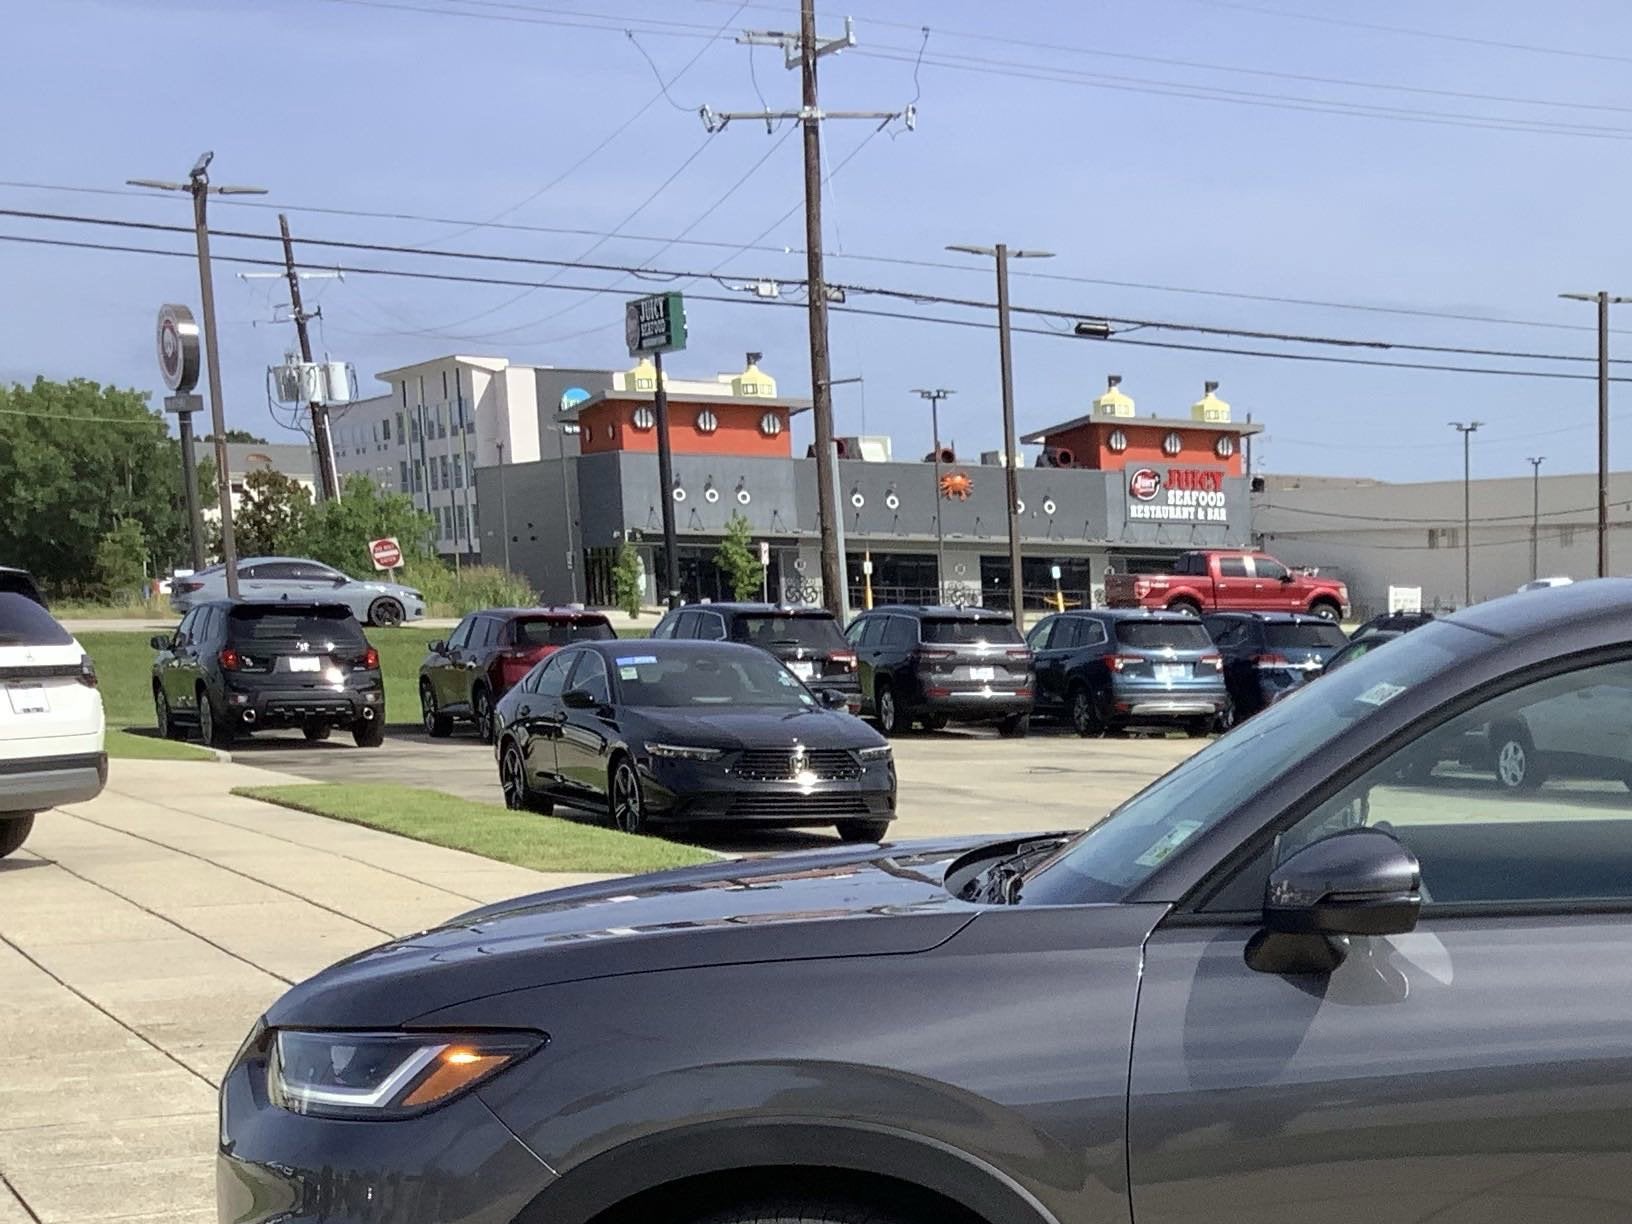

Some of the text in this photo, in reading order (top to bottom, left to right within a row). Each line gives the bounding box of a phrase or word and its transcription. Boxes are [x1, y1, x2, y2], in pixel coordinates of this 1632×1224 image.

[640, 296, 665, 322] JUICY
[1163, 470, 1225, 490] JUICY
[1167, 490, 1225, 507] SEAFOOD
[1130, 504, 1227, 521] RESTAURANT & BAR
